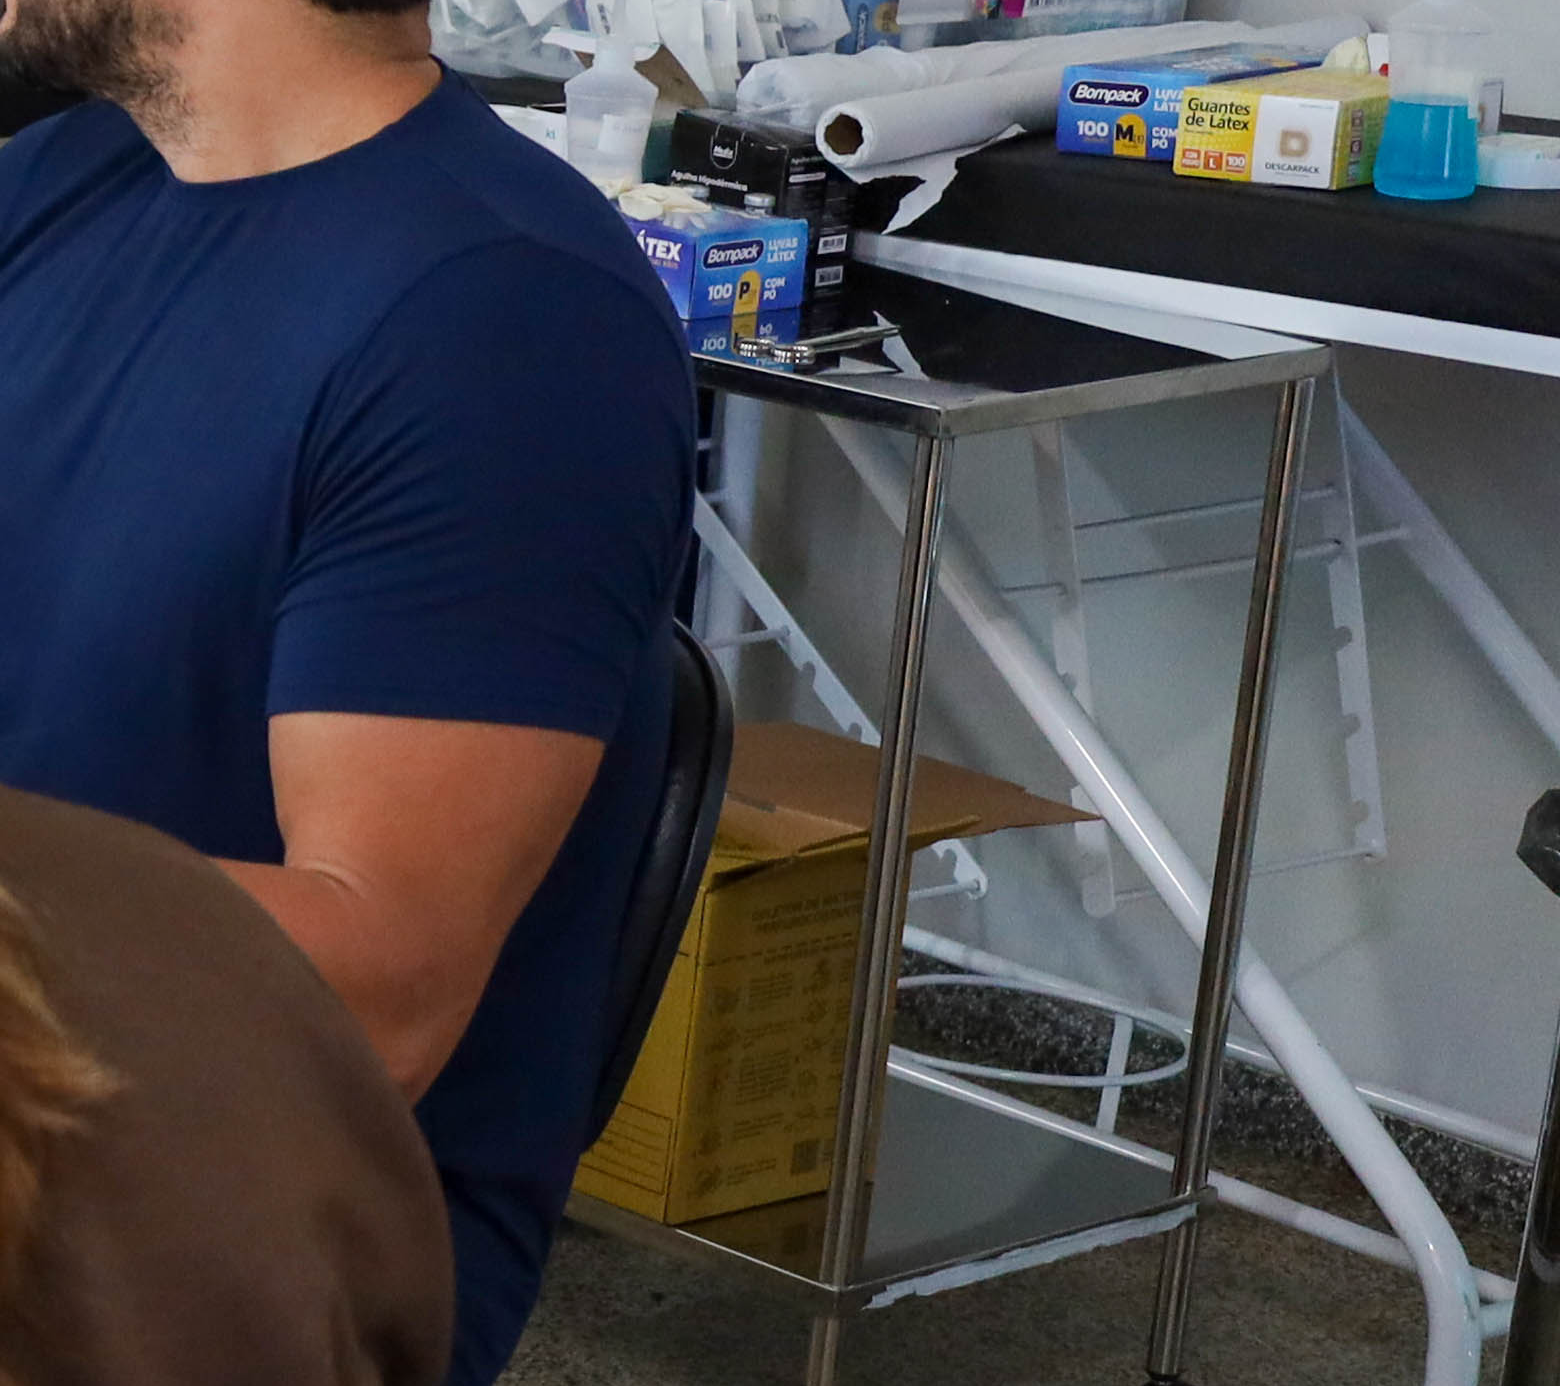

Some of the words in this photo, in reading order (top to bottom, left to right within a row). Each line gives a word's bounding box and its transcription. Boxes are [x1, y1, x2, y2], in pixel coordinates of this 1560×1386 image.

[1075, 84, 1142, 103] Bompack
[1188, 97, 1251, 115] Guantes
[1077, 120, 1109, 137] 100
[1115, 124, 1134, 141] M
[1185, 112, 1205, 126] de
[1209, 113, 1249, 131] Látex
[1265, 162, 1320, 174] DESCARPACK
[707, 244, 760, 264] Bompack
[769, 237, 798, 250] LUVAS
[707, 284, 733, 300] 100
[739, 282, 750, 299] P
[764, 277, 785, 288] COM
